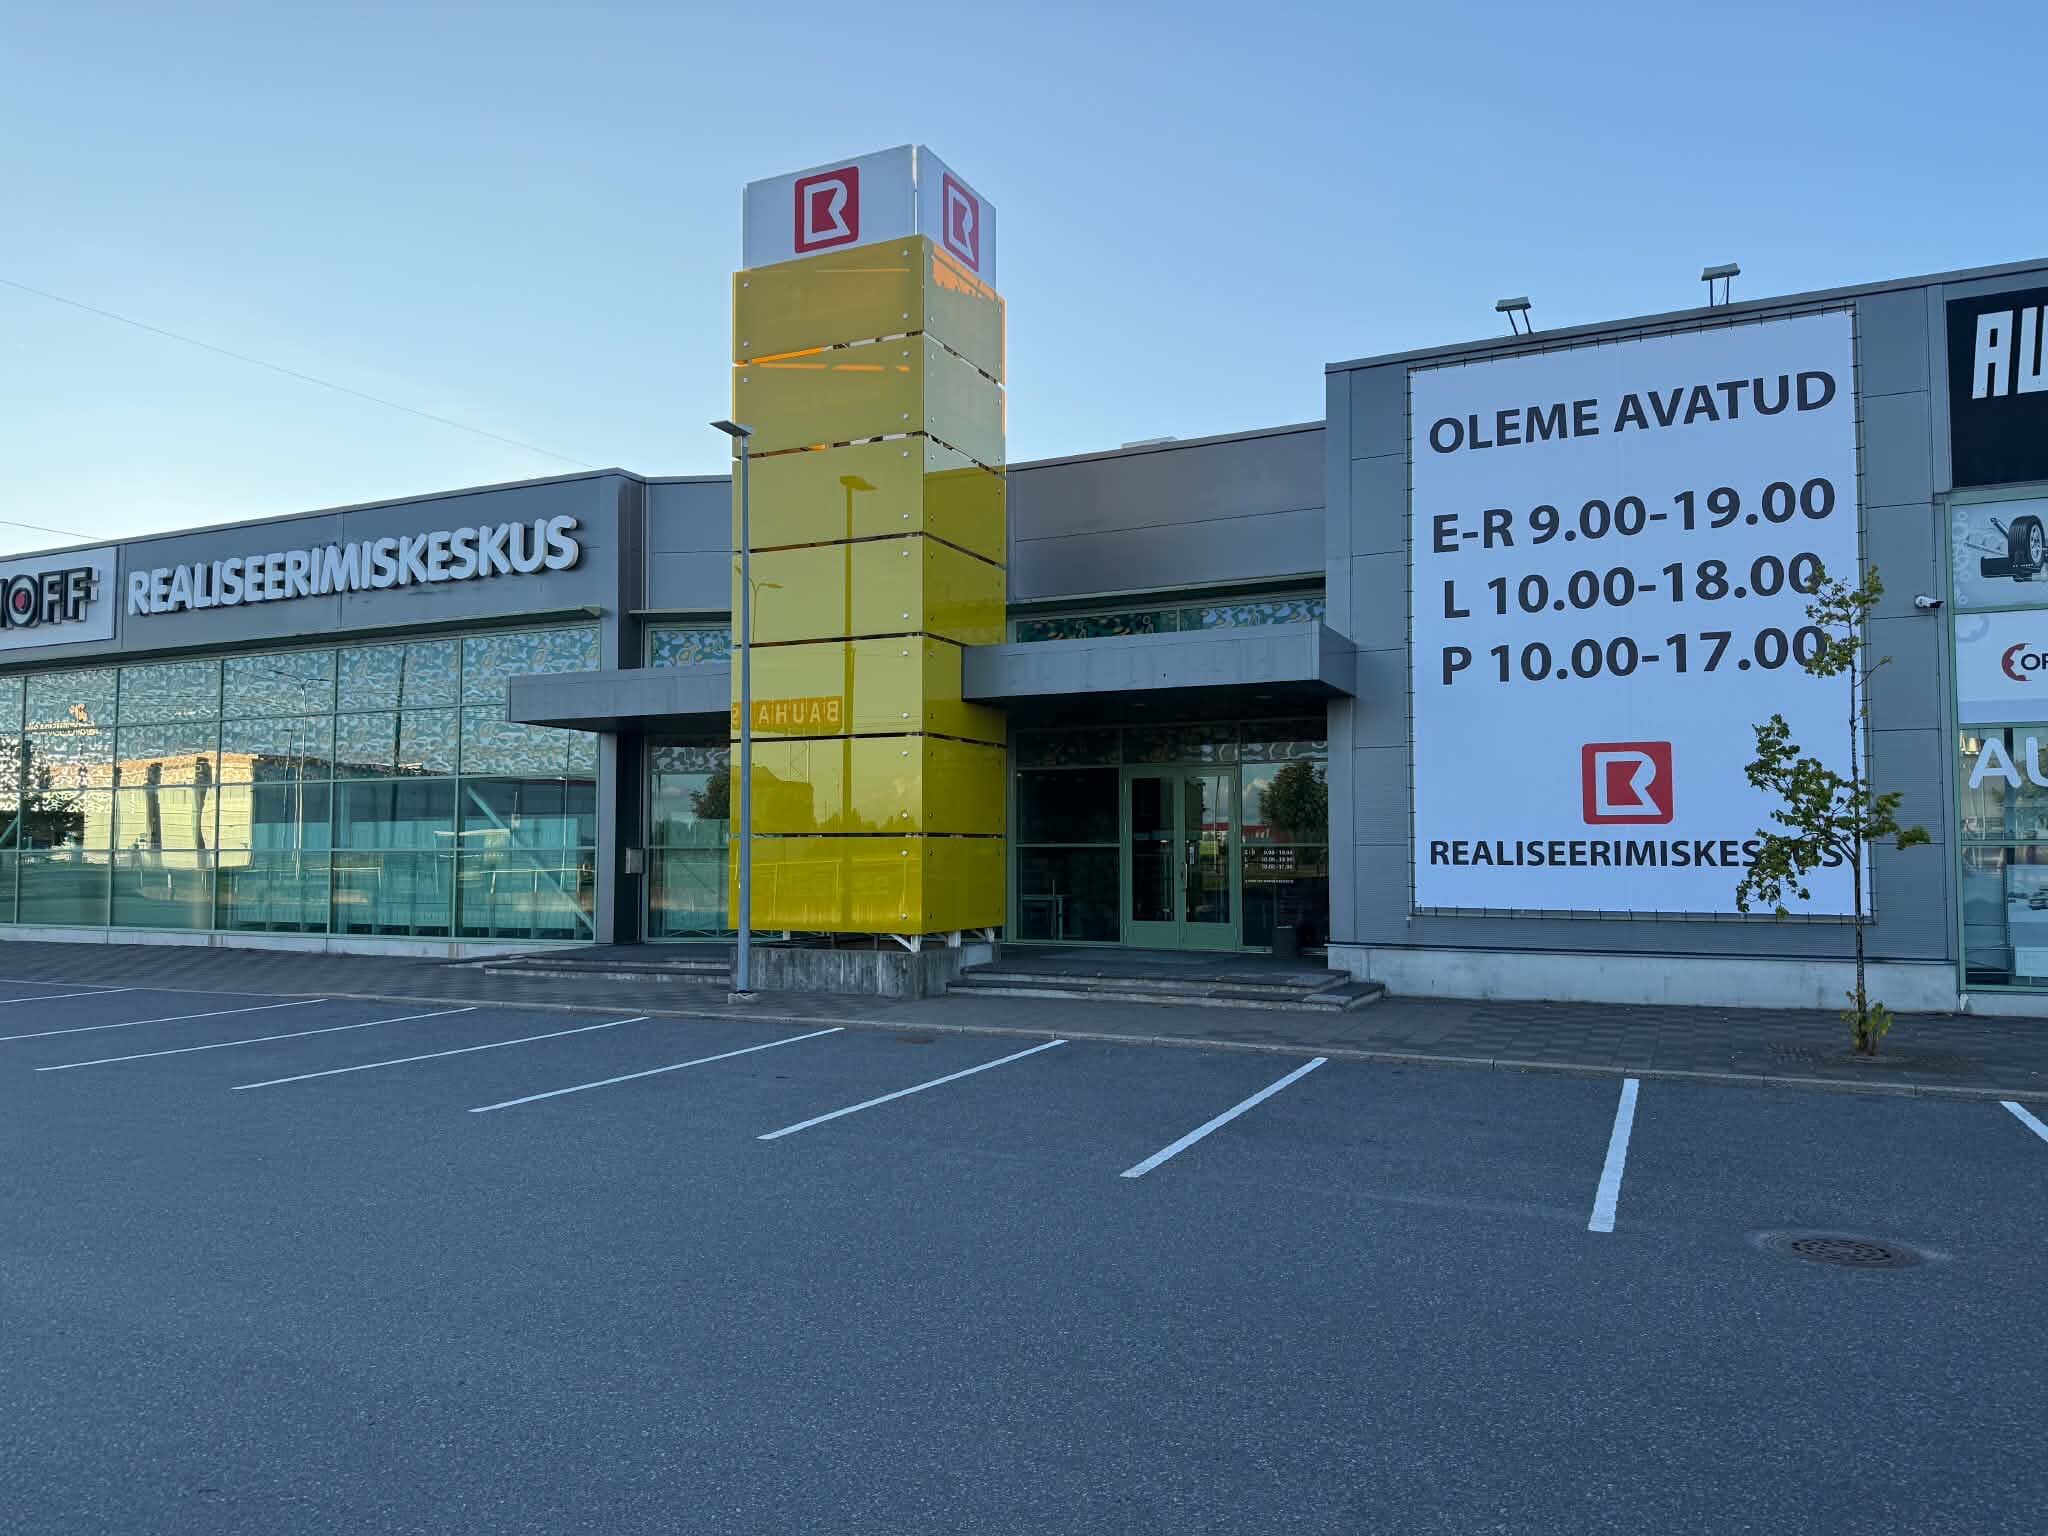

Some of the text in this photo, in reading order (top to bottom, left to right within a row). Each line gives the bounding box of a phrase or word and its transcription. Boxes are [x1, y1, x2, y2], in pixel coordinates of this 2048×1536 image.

[1429, 371, 1836, 454] OLEME AVATUD
[1432, 477, 1836, 554] E-R 9.00-19.00
[0, 567, 99, 628] OFF
[128, 515, 580, 616] REALISEERIMISKESKUS
[1444, 552, 1825, 619] L 10.00-18.00
[1442, 625, 1827, 686] P 10.00-17.00
[1430, 839, 1844, 868] REALISEERIMISKESS
